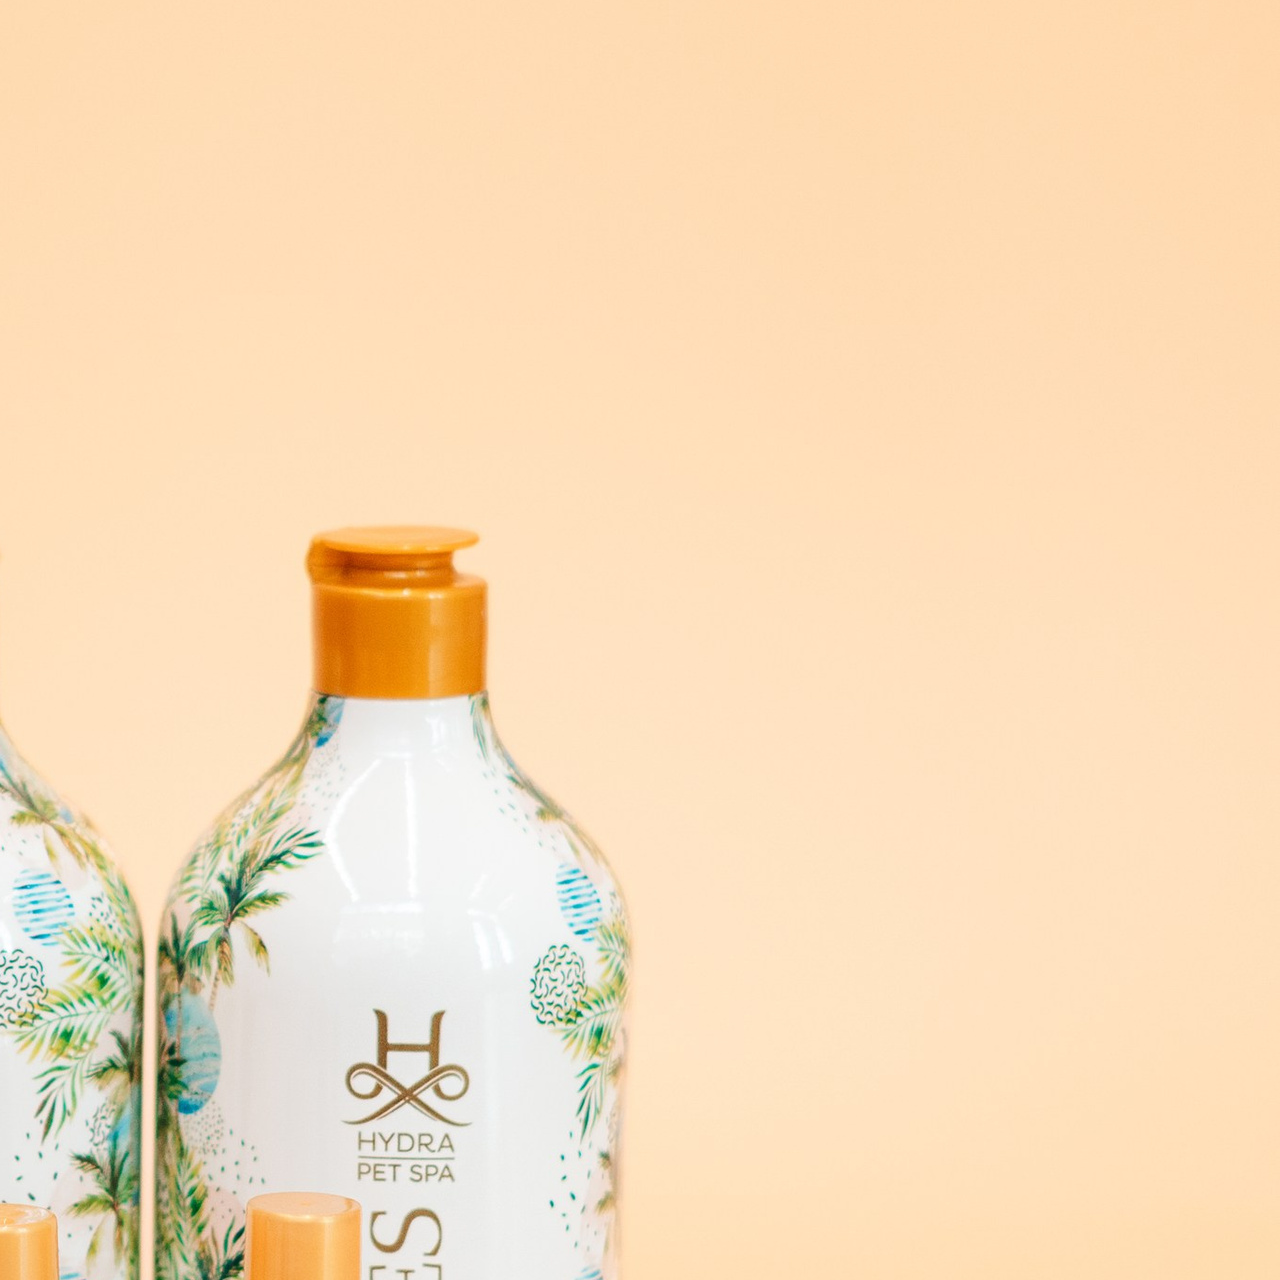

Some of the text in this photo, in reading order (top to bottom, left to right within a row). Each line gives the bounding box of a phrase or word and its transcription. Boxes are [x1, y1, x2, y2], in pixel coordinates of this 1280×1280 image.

[357, 1131, 456, 1155] HYDRA
[357, 1162, 456, 1184] PET SPA
